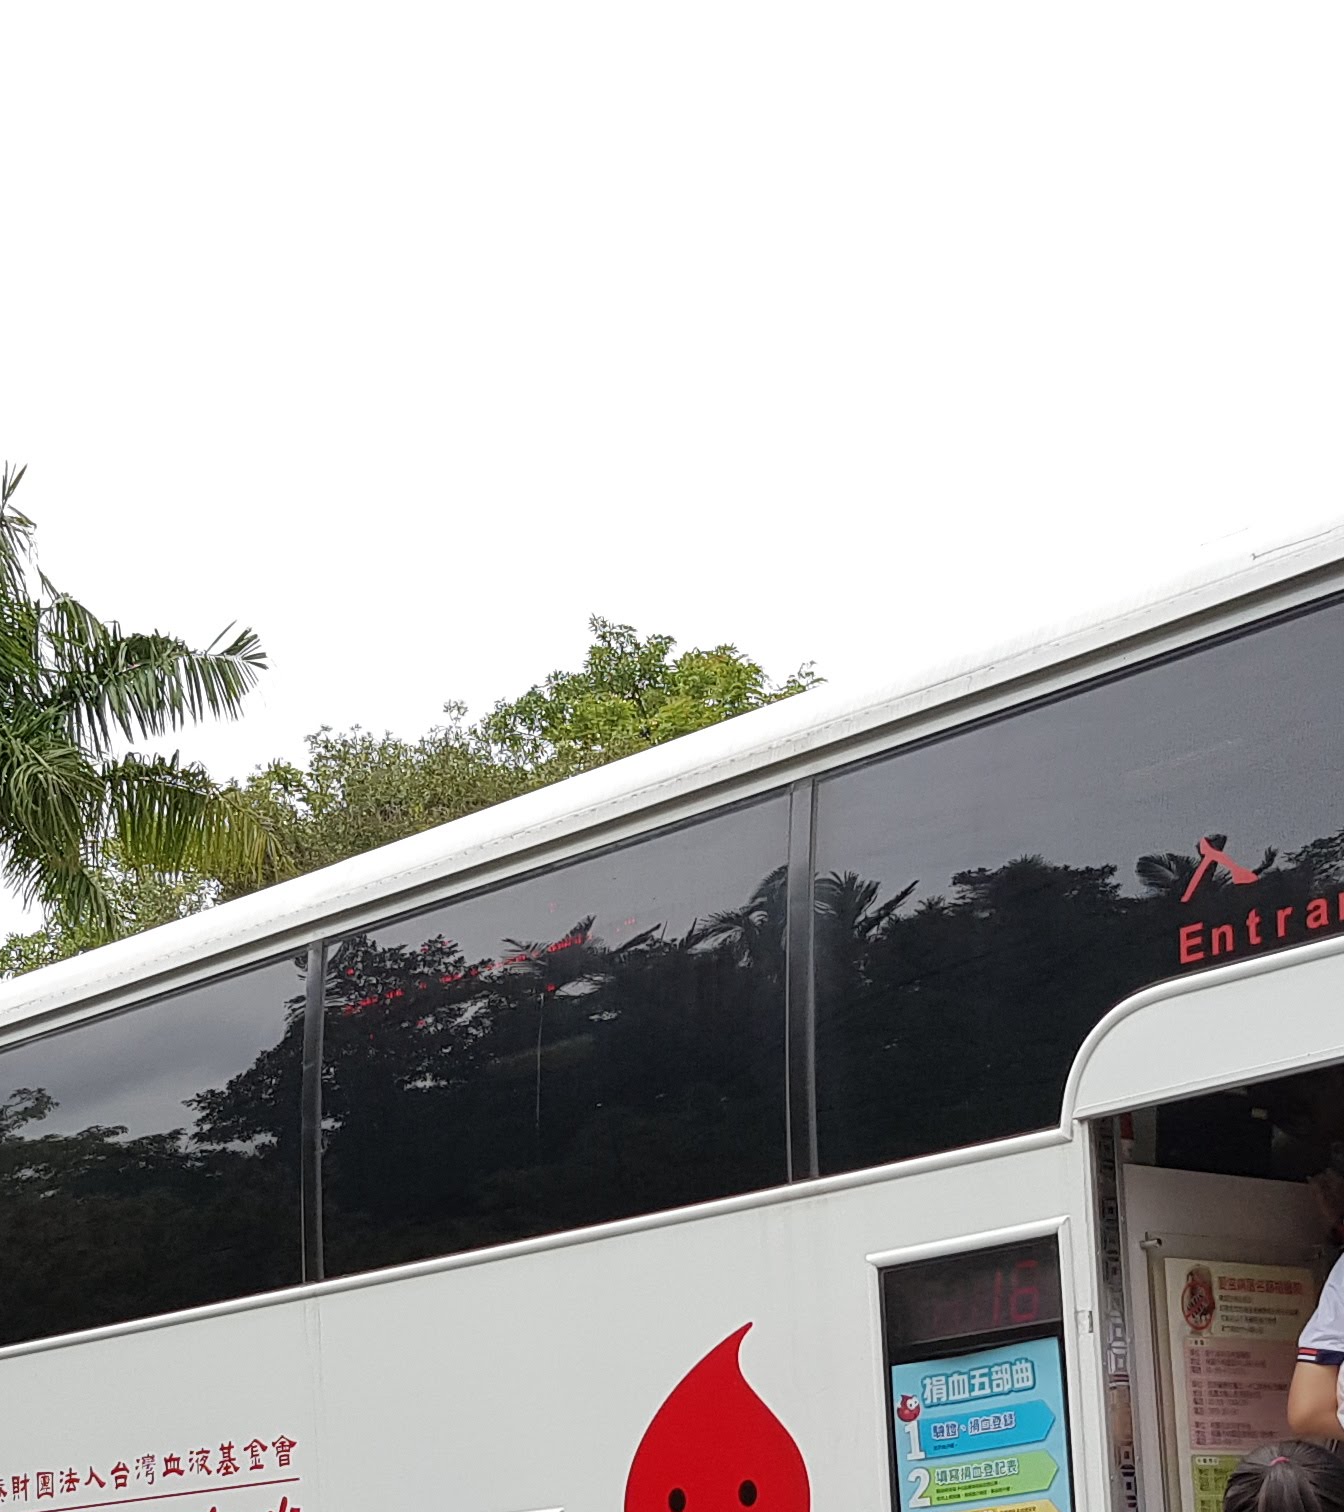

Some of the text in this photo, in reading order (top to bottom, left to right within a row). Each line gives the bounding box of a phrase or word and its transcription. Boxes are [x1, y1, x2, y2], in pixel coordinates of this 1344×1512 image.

[922, 1360, 1034, 1404] 捐血五部曲
[908, 1467, 932, 1509] 2
